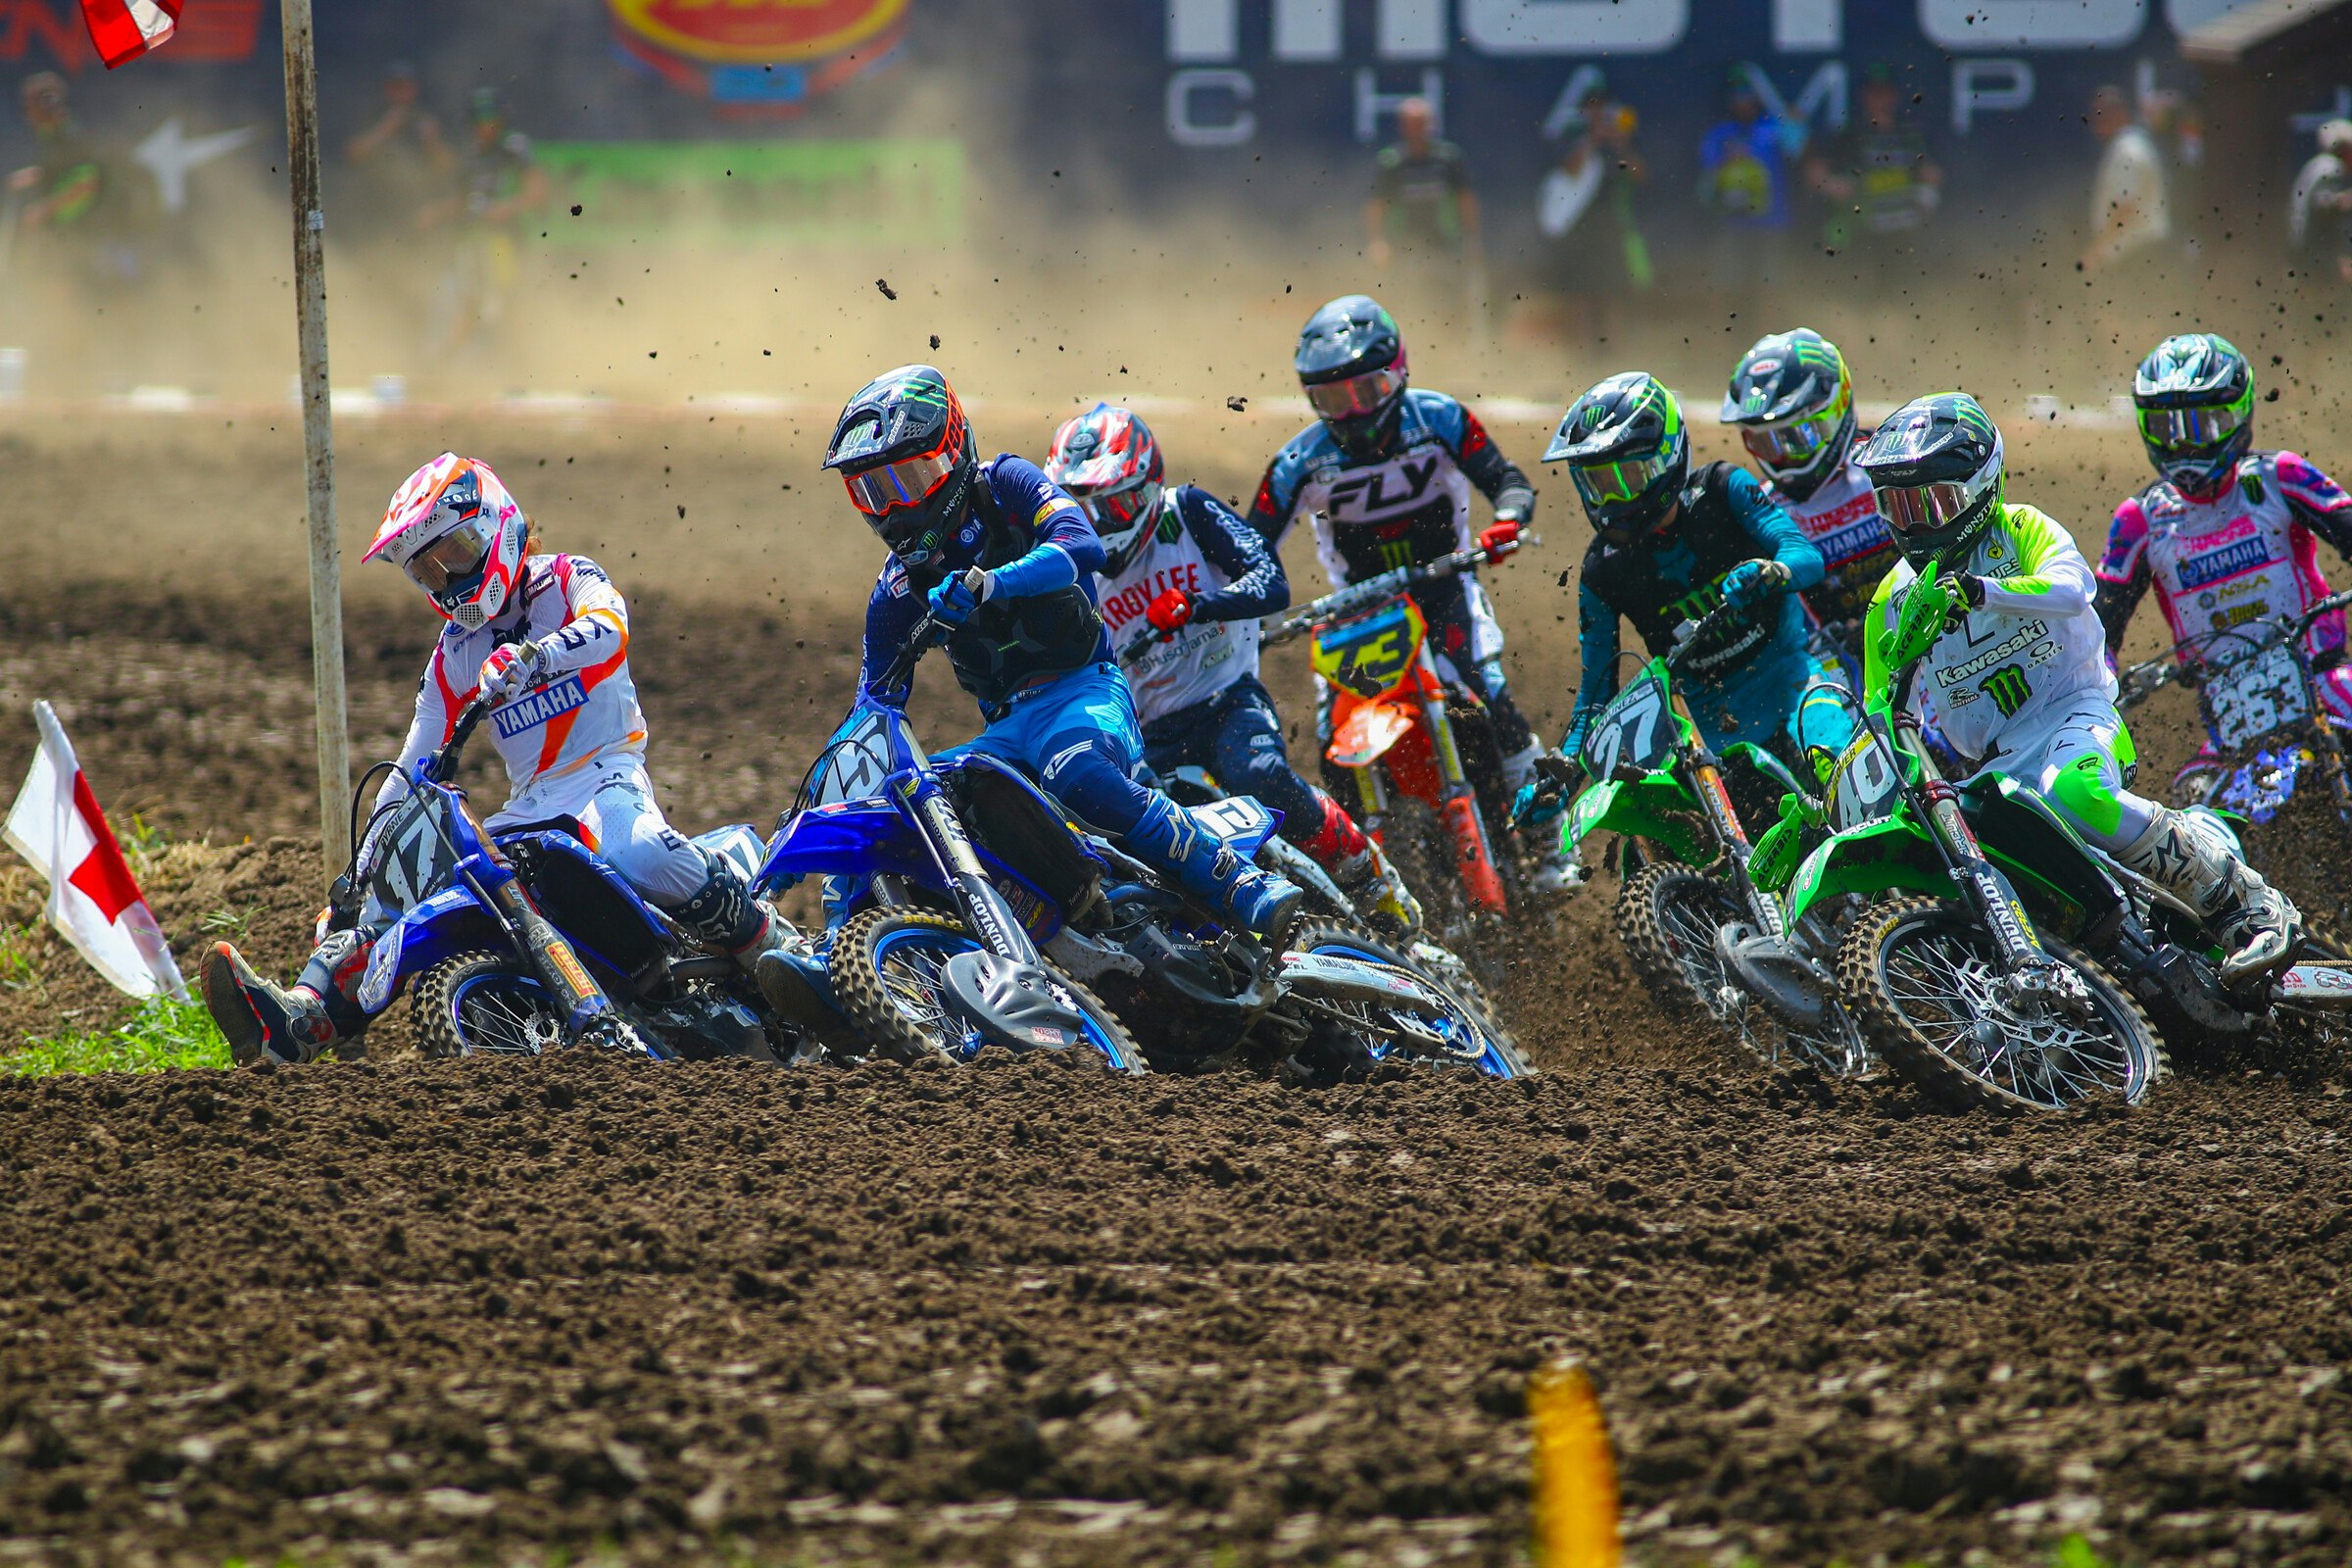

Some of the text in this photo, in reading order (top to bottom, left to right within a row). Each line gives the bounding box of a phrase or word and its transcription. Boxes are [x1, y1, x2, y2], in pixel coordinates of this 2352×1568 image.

[1330, 455, 1438, 515] FLY
[2197, 538, 2266, 574] YAMAHA
[1687, 623, 1766, 668] Kawasaki
[1936, 618, 2011, 689] Kawasaki
[2027, 644, 2064, 670] OAKLEY
[495, 680, 584, 735] YAMAHA
[967, 893, 1011, 957] DUNLOP
[1975, 871, 2029, 953] DUNLOP
[548, 942, 596, 997] PIRELLI
